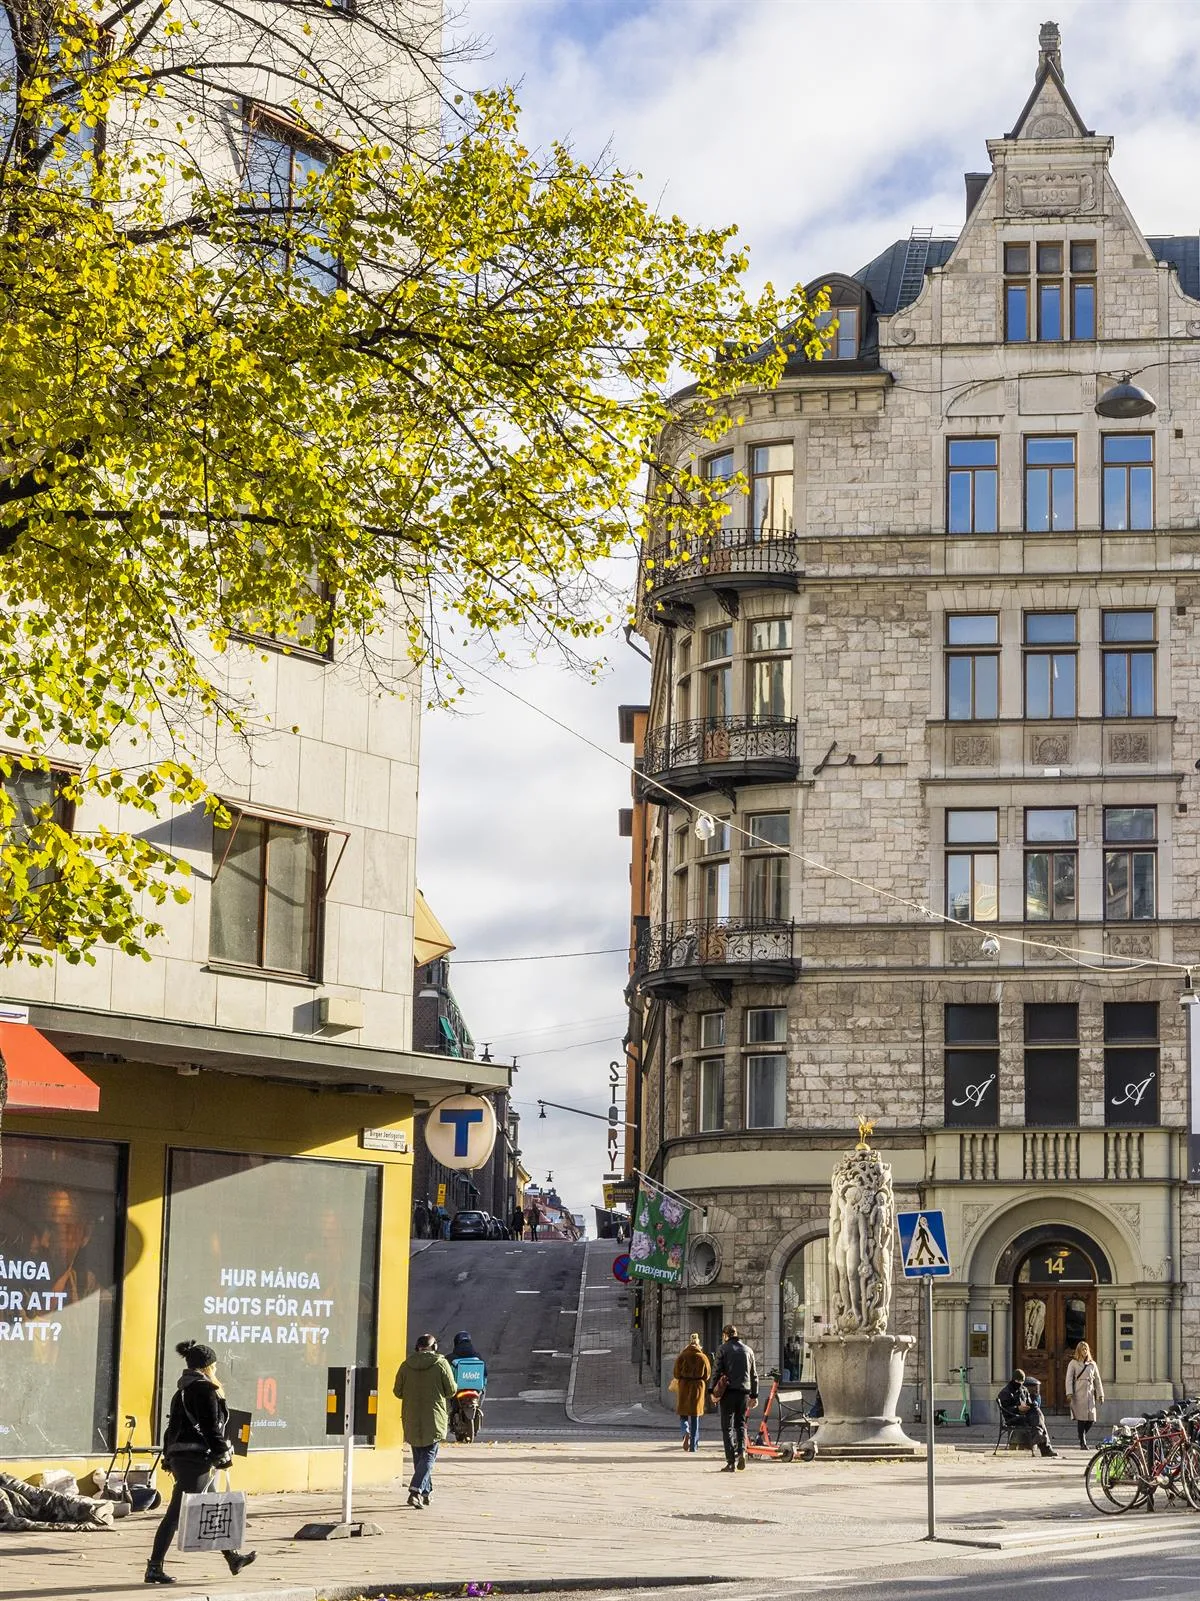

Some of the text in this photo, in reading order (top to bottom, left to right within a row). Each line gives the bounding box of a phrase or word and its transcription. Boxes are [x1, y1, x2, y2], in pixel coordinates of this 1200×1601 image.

[608, 1061, 619, 1172] STORY
[440, 1109, 483, 1156] T
[1044, 1257, 1065, 1274] 14
[220, 1266, 321, 1290] HUR MÅNGA
[27, 1291, 67, 1311] ATT
[203, 1294, 334, 1317] SHOTS FÖR ATT
[205, 1321, 330, 1345] TRÄFFA RÄTT?
[462, 1371, 480, 1379] Wolt
[256, 1376, 277, 1416] IQ
